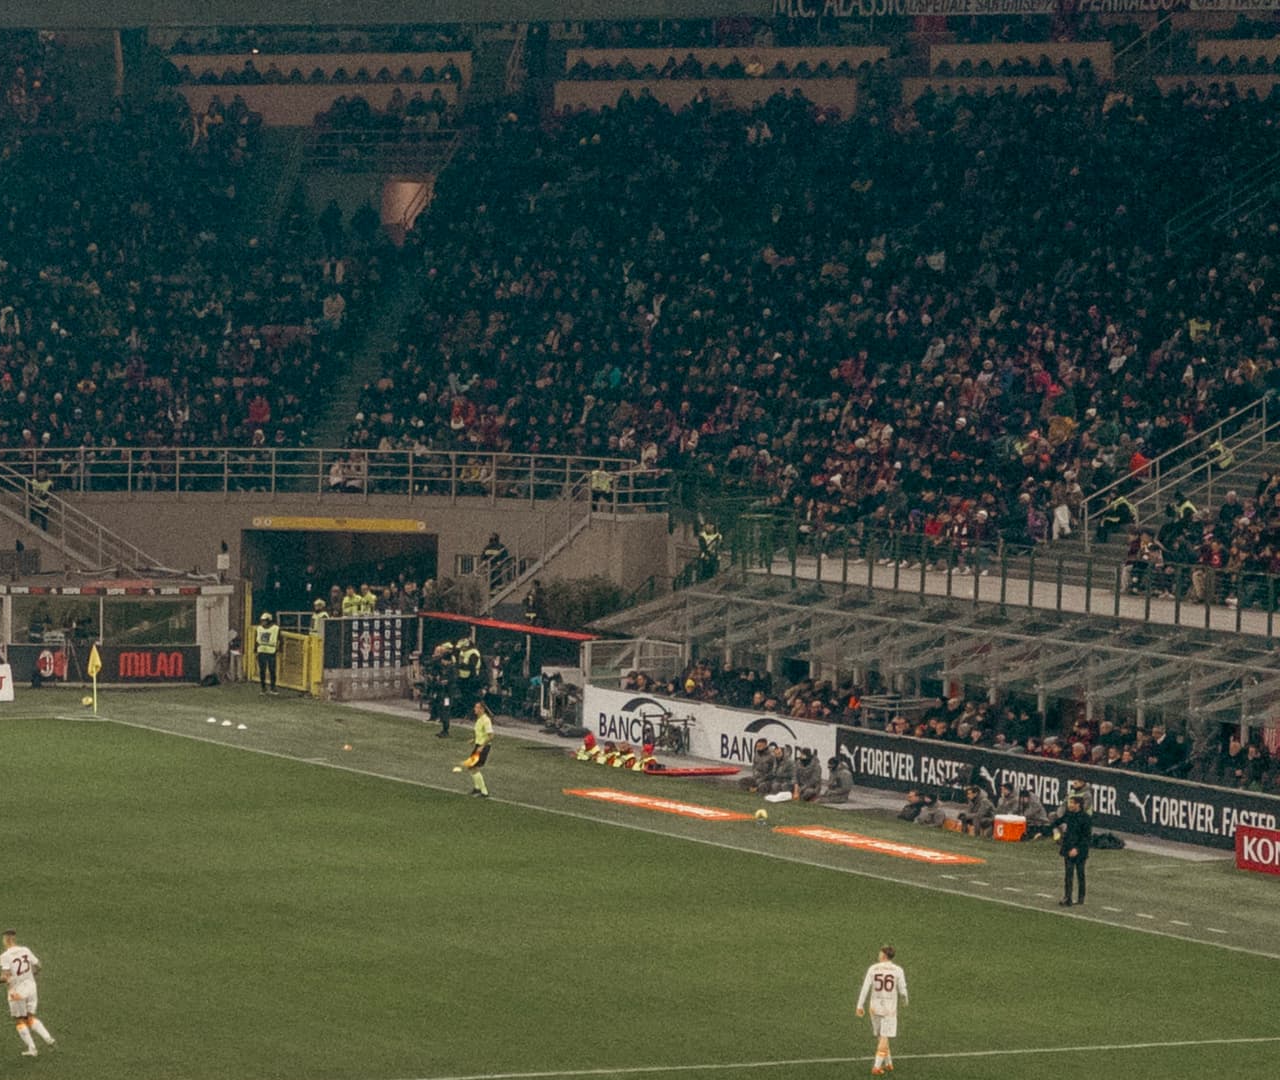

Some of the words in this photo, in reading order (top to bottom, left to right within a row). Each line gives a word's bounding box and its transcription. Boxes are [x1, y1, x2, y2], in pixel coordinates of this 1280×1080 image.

[119, 651, 184, 677] MILAN
[860, 747, 918, 783] FOREVER.
[1067, 780, 1121, 816] FTER.
[1152, 795, 1219, 835] FOREVER.
[13, 954, 30, 976] 23
[874, 974, 895, 992] 56
